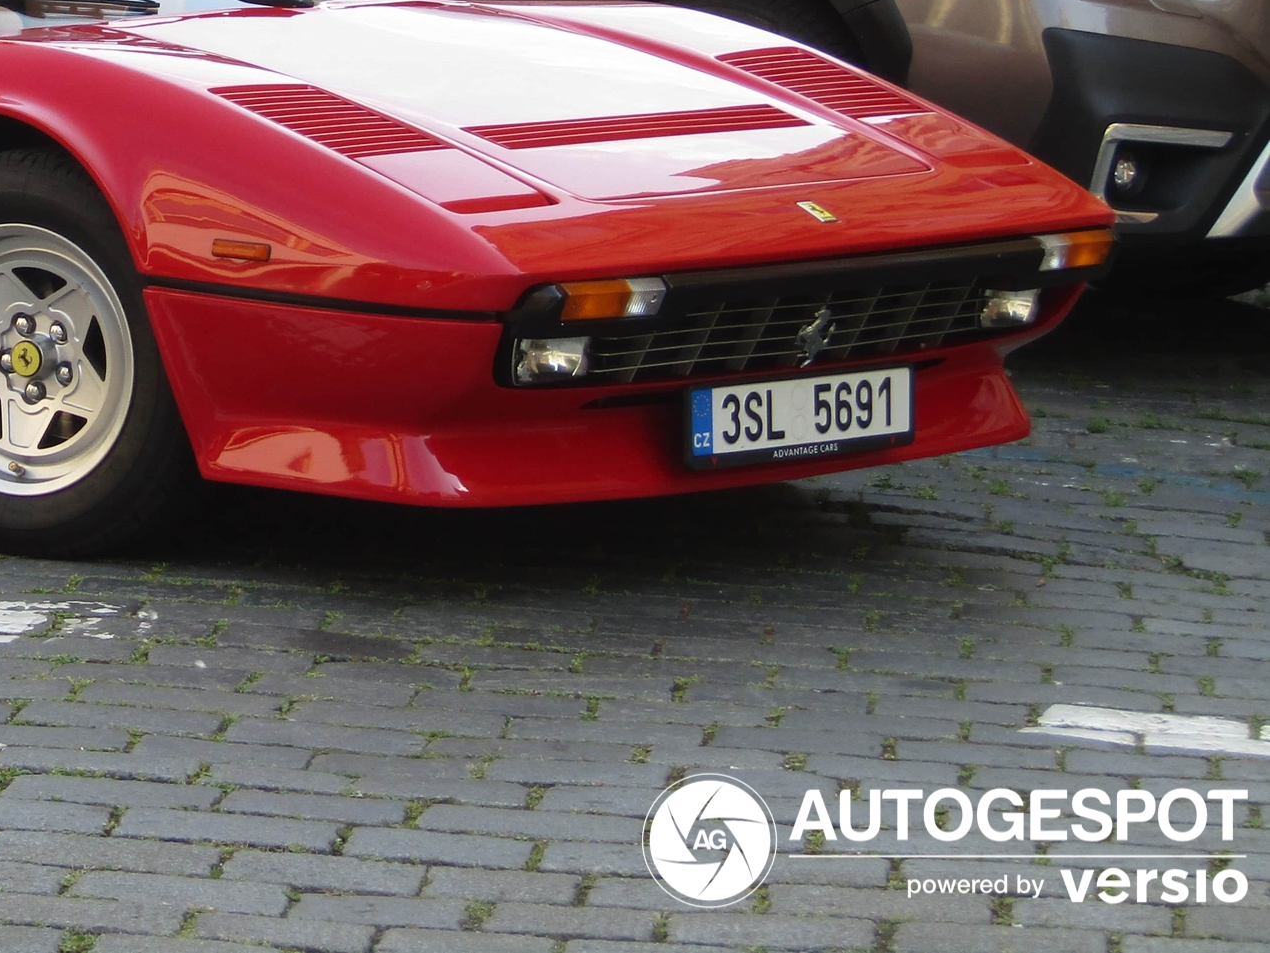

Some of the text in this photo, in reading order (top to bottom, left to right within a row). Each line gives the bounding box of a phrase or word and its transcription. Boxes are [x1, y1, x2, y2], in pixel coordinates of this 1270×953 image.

[722, 376, 892, 445] 3SL 5691
[693, 432, 711, 448] CZ
[773, 442, 839, 459] ADVANTAGE CARS
